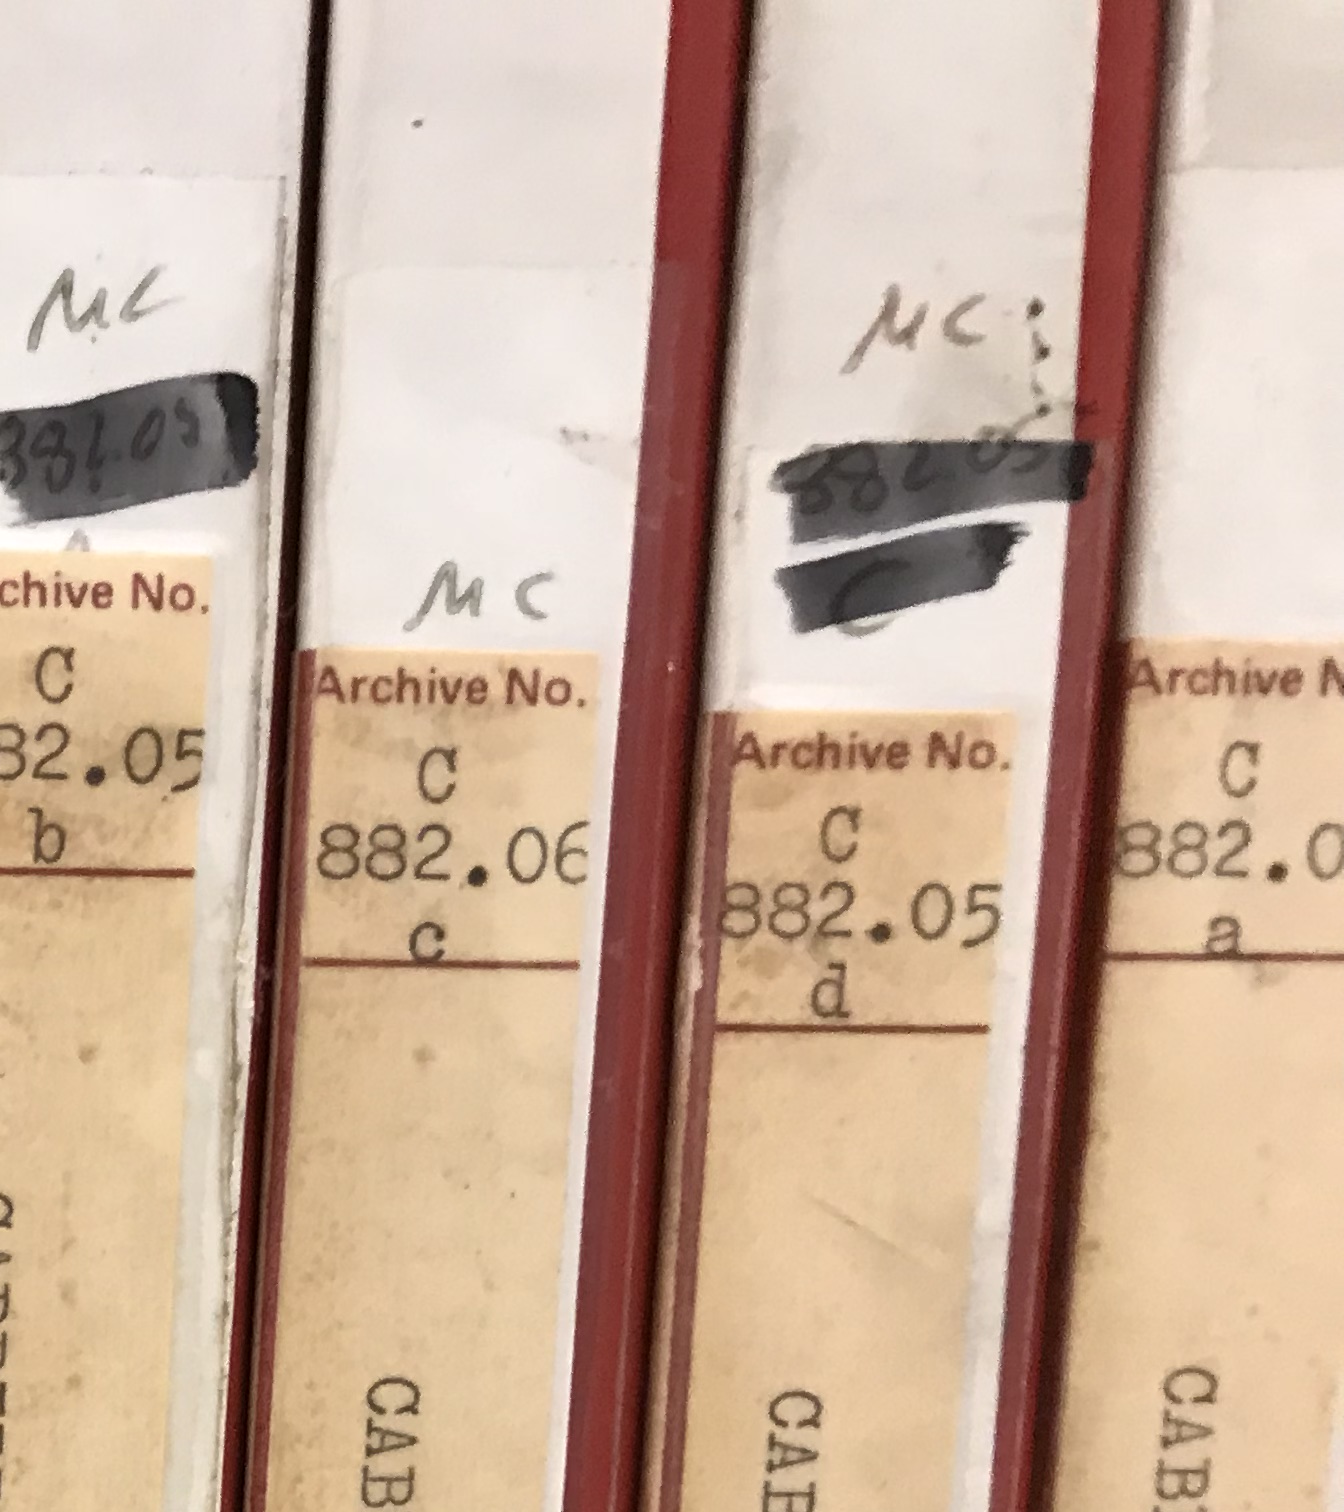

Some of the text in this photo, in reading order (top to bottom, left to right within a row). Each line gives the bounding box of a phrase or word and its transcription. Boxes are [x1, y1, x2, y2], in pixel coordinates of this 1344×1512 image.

[26, 263, 172, 354] MC
[838, 283, 989, 375] MC
[131, 571, 211, 615] No.
[402, 560, 557, 632] MC
[35, 645, 75, 705] C
[313, 664, 588, 710] Archive No.
[1127, 656, 1305, 698] Archive
[418, 746, 458, 805] C
[730, 730, 1012, 773] Archive No.
[1219, 739, 1261, 799] C
[27, 806, 67, 865] b
[317, 818, 590, 888] 882.06
[820, 805, 862, 864] C
[721, 880, 1005, 950] 882.05
[811, 962, 852, 1020] d
